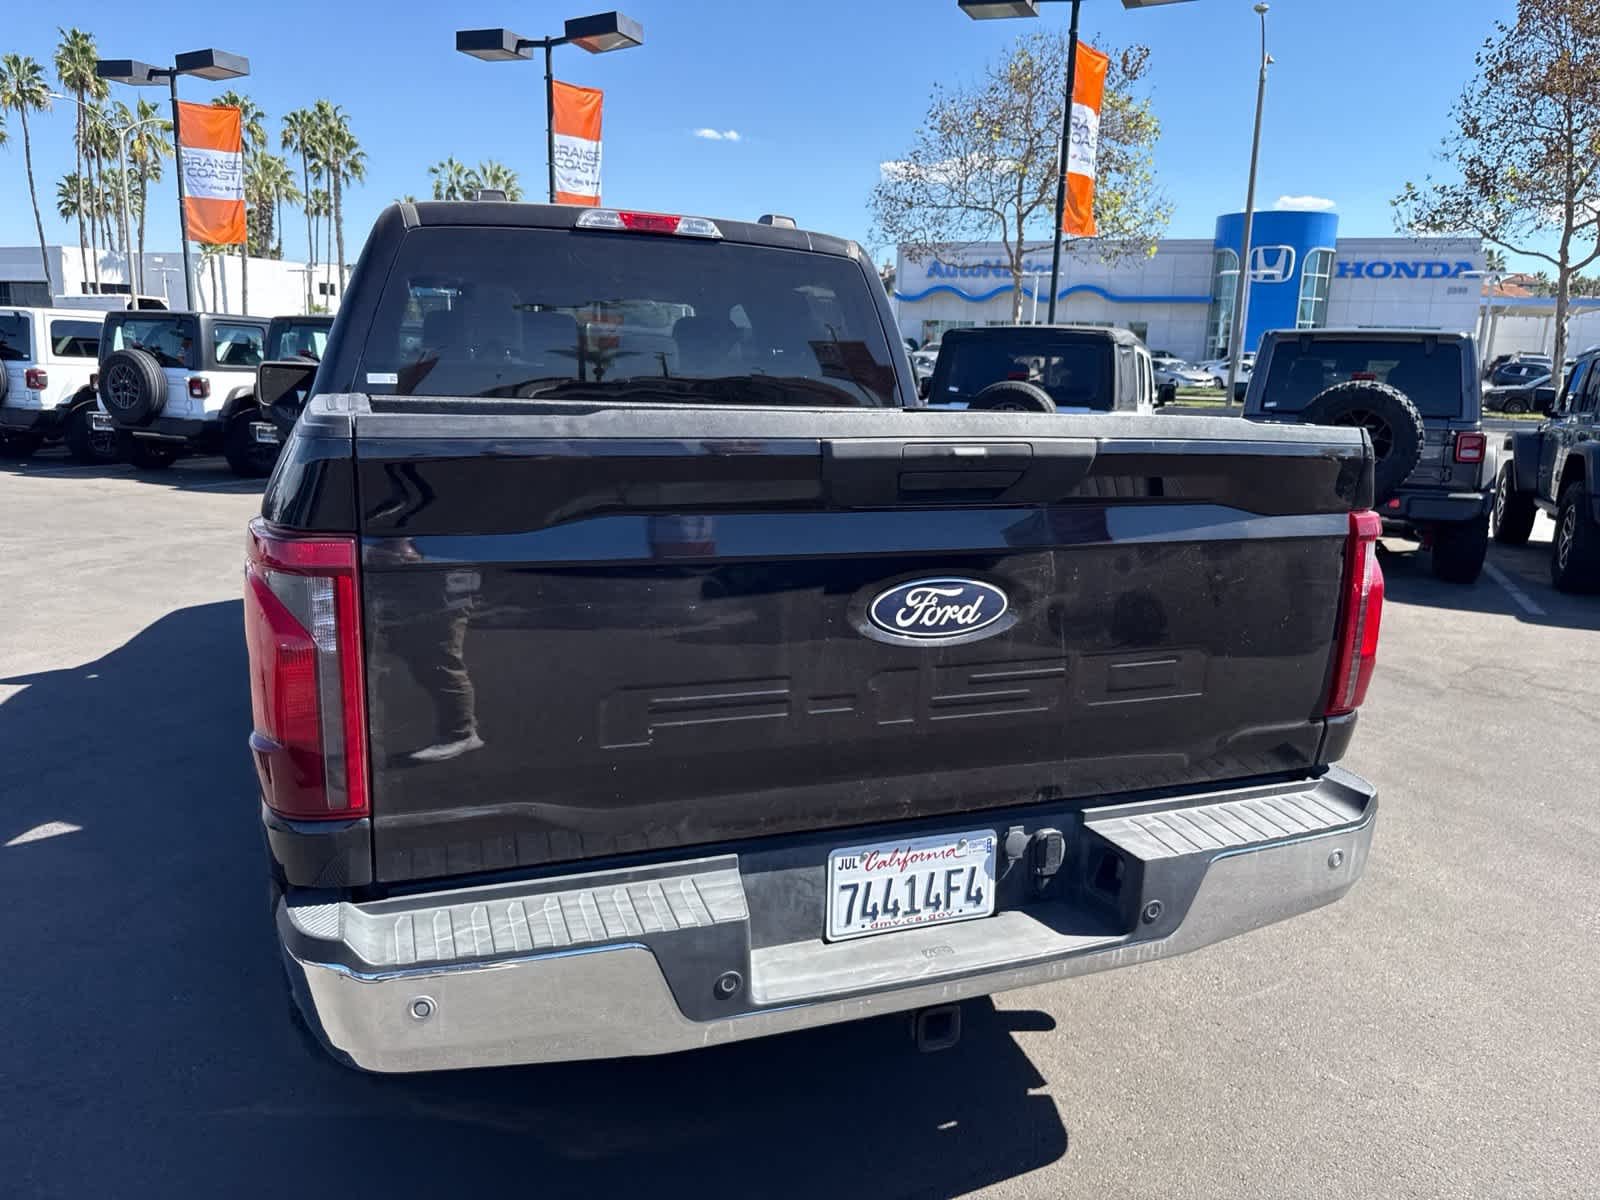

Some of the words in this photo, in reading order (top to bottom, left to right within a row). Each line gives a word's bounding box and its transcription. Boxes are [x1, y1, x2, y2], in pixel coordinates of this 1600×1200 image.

[187, 167, 238, 182] COAST
[926, 258, 1057, 279] AutoNaio
[1335, 261, 1480, 279] HONDA
[895, 586, 984, 627] Ford
[838, 858, 858, 871] JUL
[864, 846, 967, 873] California
[839, 866, 984, 928] 74414F4
[870, 910, 955, 930] dmv.ca.gov
